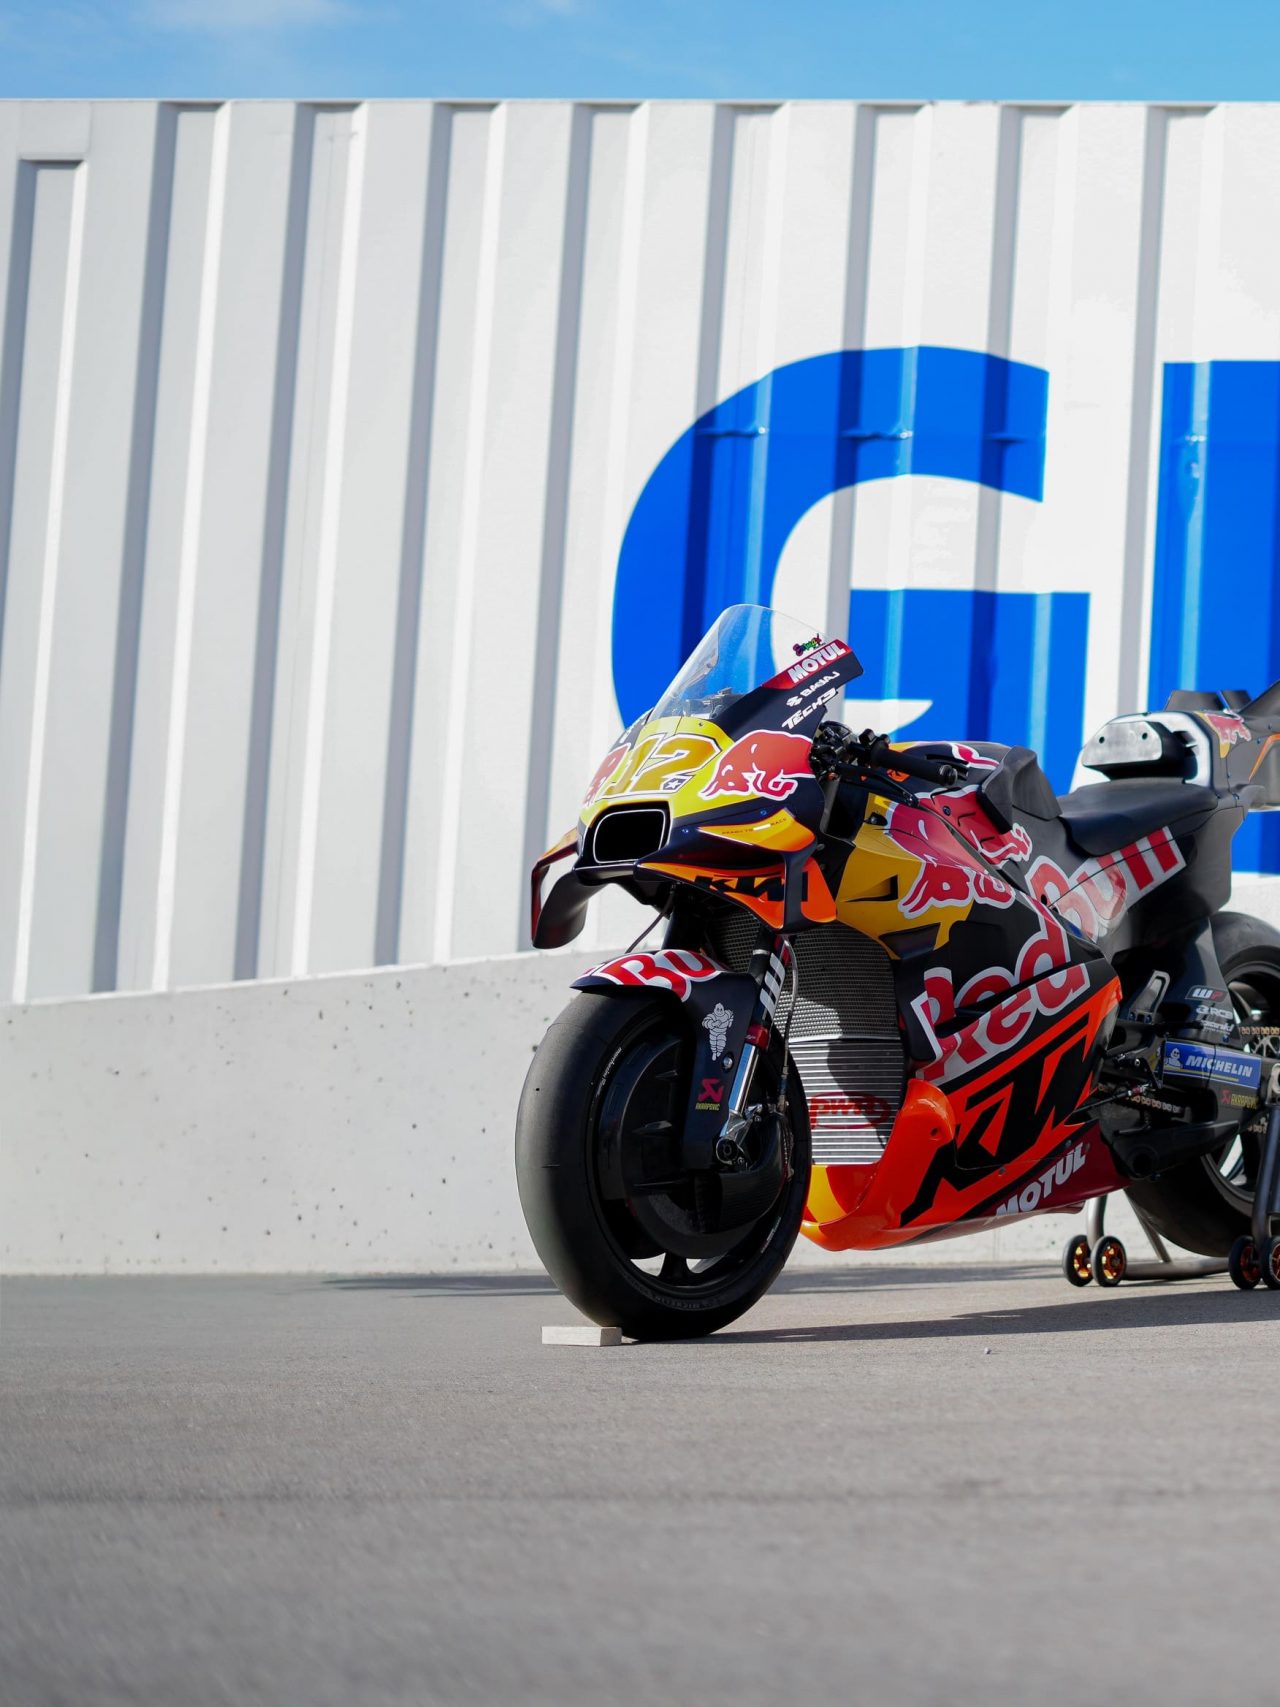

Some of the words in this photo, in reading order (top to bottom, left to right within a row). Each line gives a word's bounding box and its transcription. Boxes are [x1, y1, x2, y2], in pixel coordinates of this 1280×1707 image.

[787, 642, 847, 684] MOTUL
[800, 671, 840, 697] BAJAJ
[781, 687, 837, 730] TECH3
[1024, 826, 1187, 943] Bull
[911, 892, 1091, 1086] Red
[1192, 988, 1224, 1001] WP
[1185, 1055, 1253, 1078] MICHELIN
[900, 1010, 1101, 1229] KTM
[996, 1142, 1087, 1217] MOTUL
